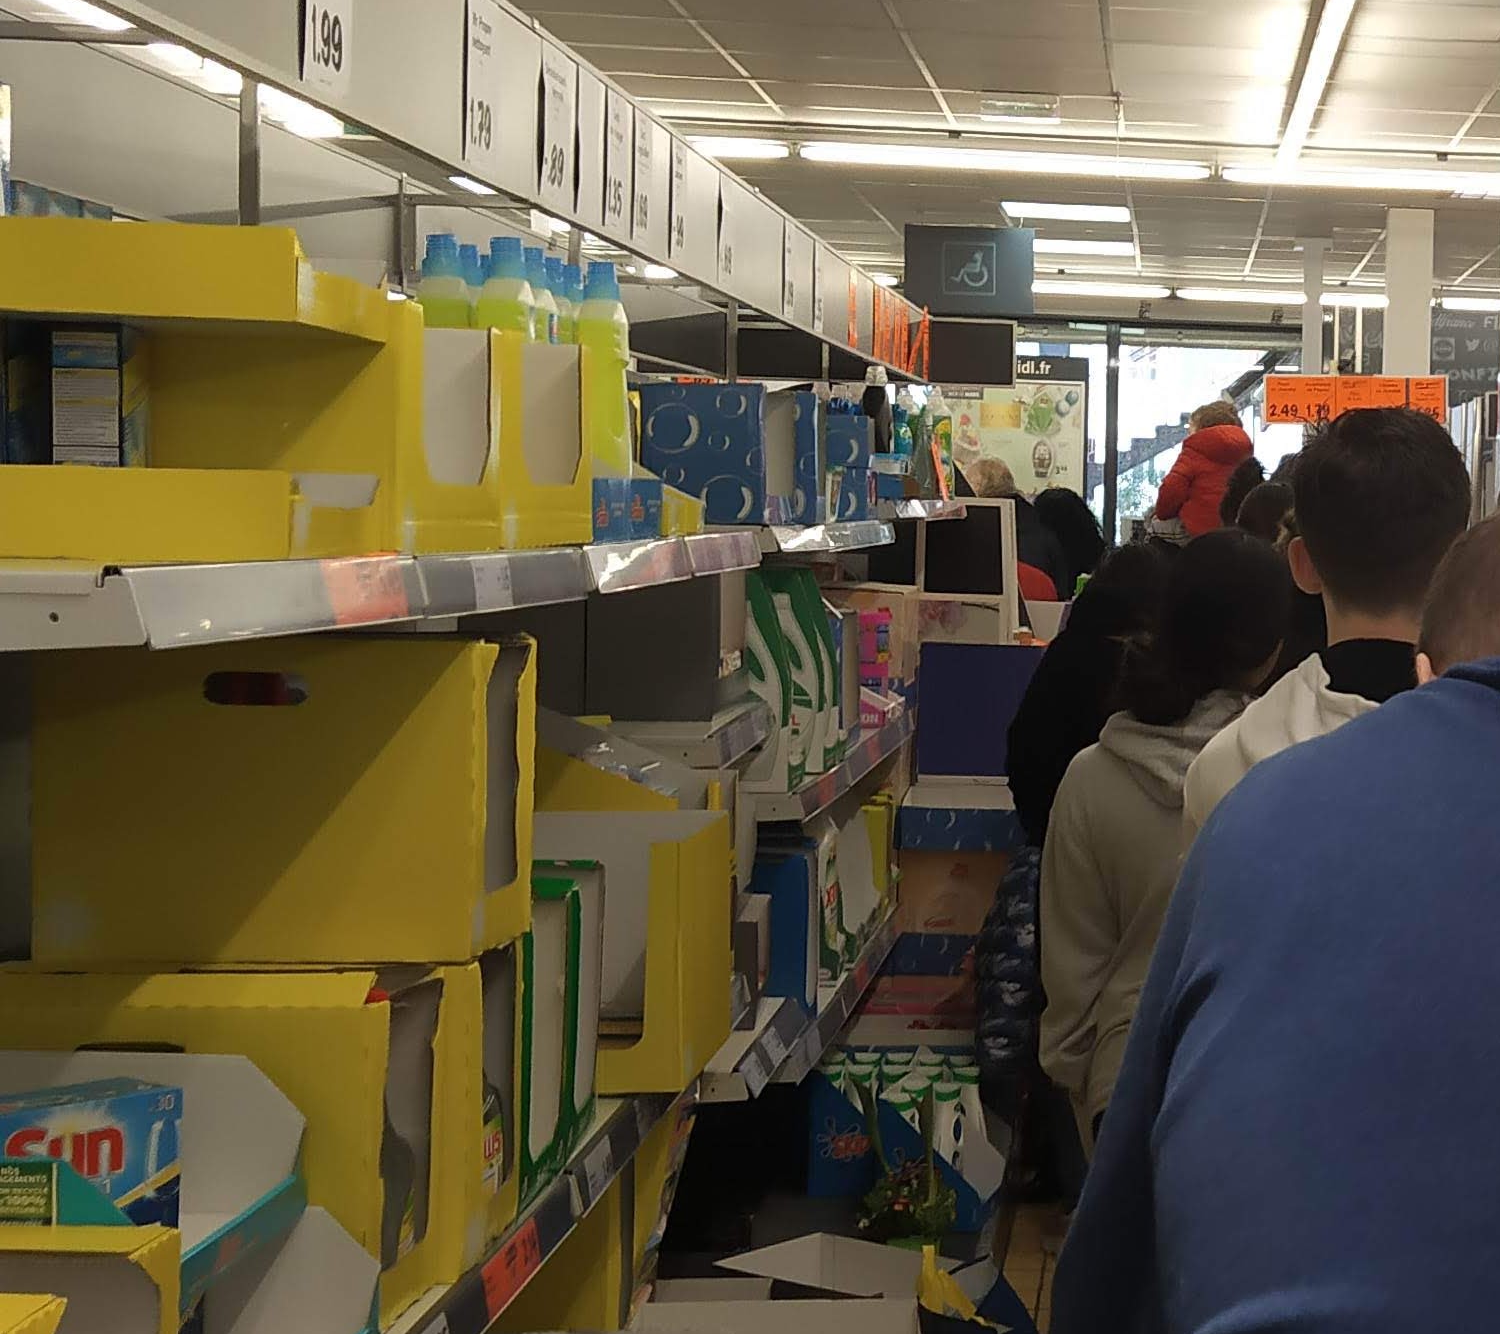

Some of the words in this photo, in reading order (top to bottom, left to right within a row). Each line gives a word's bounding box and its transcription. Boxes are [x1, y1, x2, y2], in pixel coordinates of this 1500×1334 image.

[312, 4, 343, 72] 1.99
[470, 97, 492, 151] 1.79
[1269, 403, 1298, 417] 2.49
